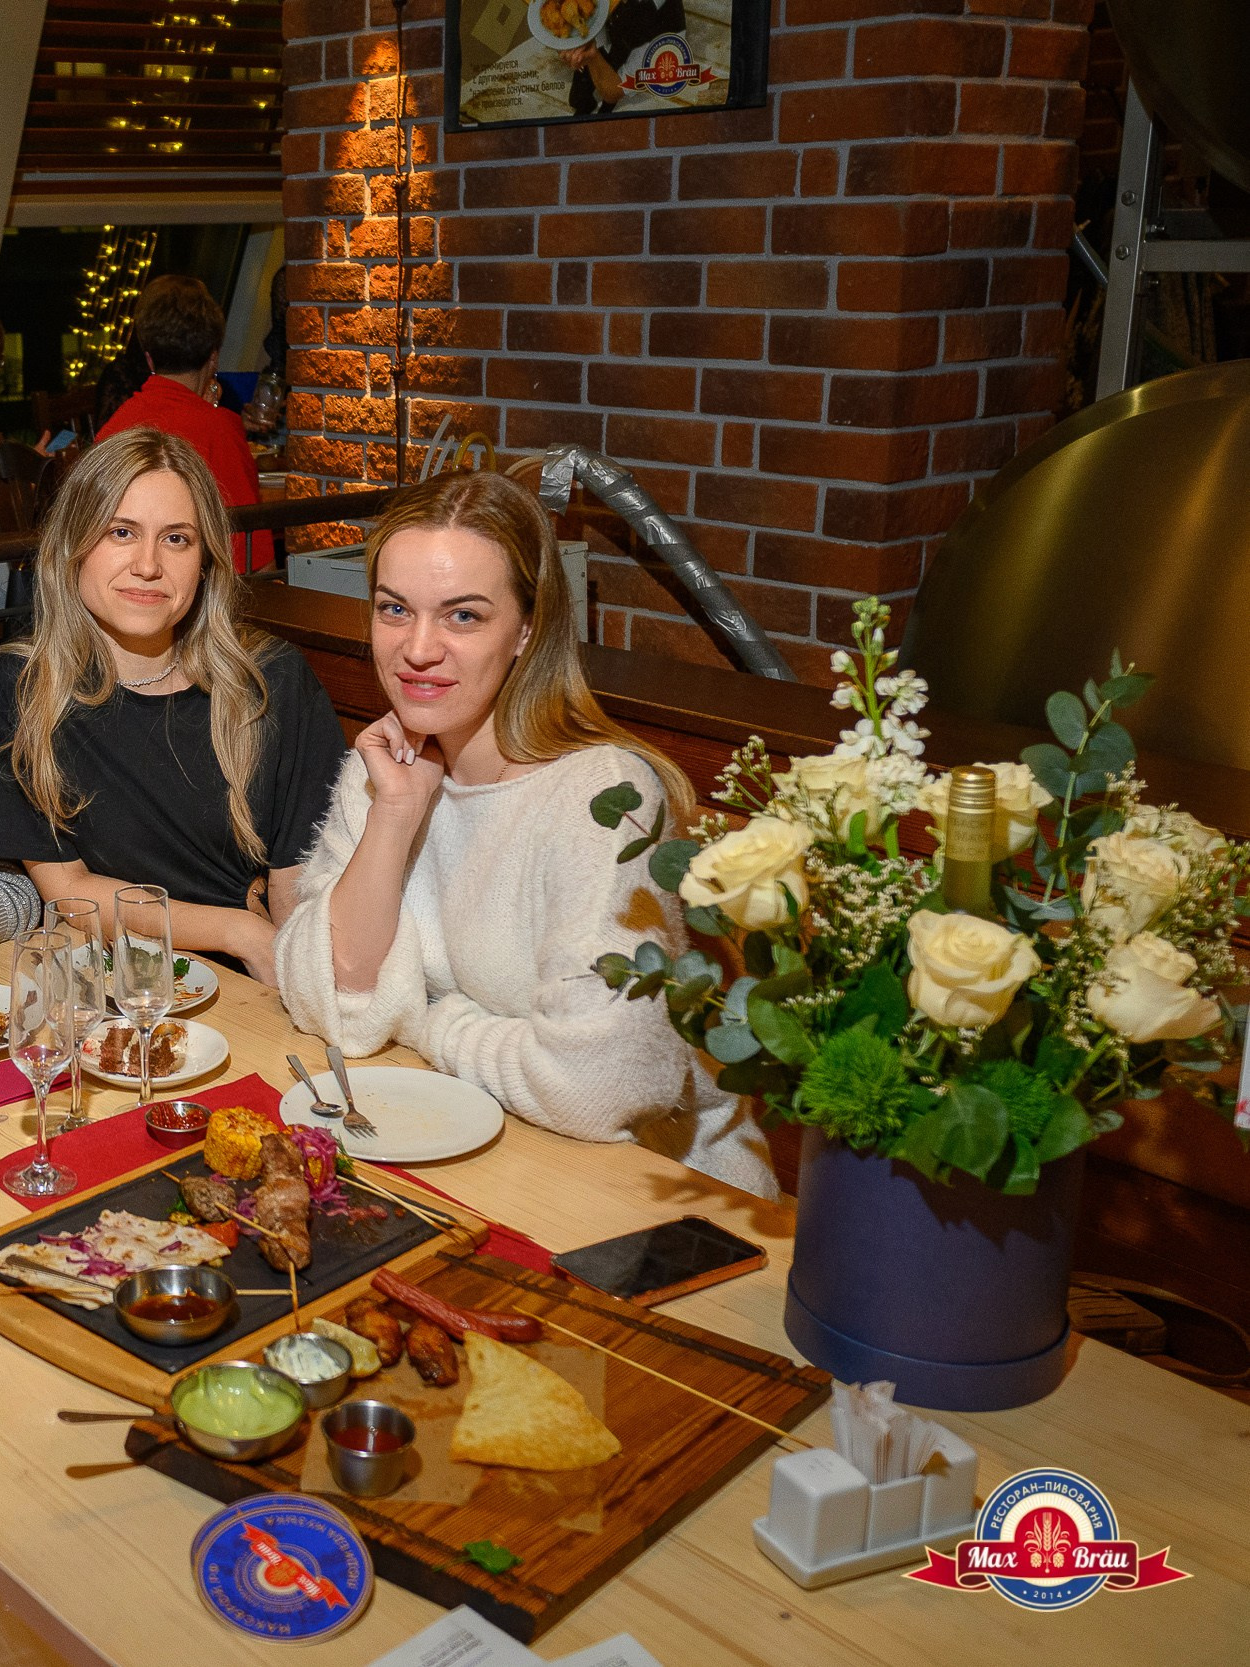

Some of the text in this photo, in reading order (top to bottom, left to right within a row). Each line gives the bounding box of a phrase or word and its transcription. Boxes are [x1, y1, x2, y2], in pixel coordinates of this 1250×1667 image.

[638, 70, 657, 81] Max
[507, 84, 540, 96] бонусных
[541, 80, 566, 92] баллов
